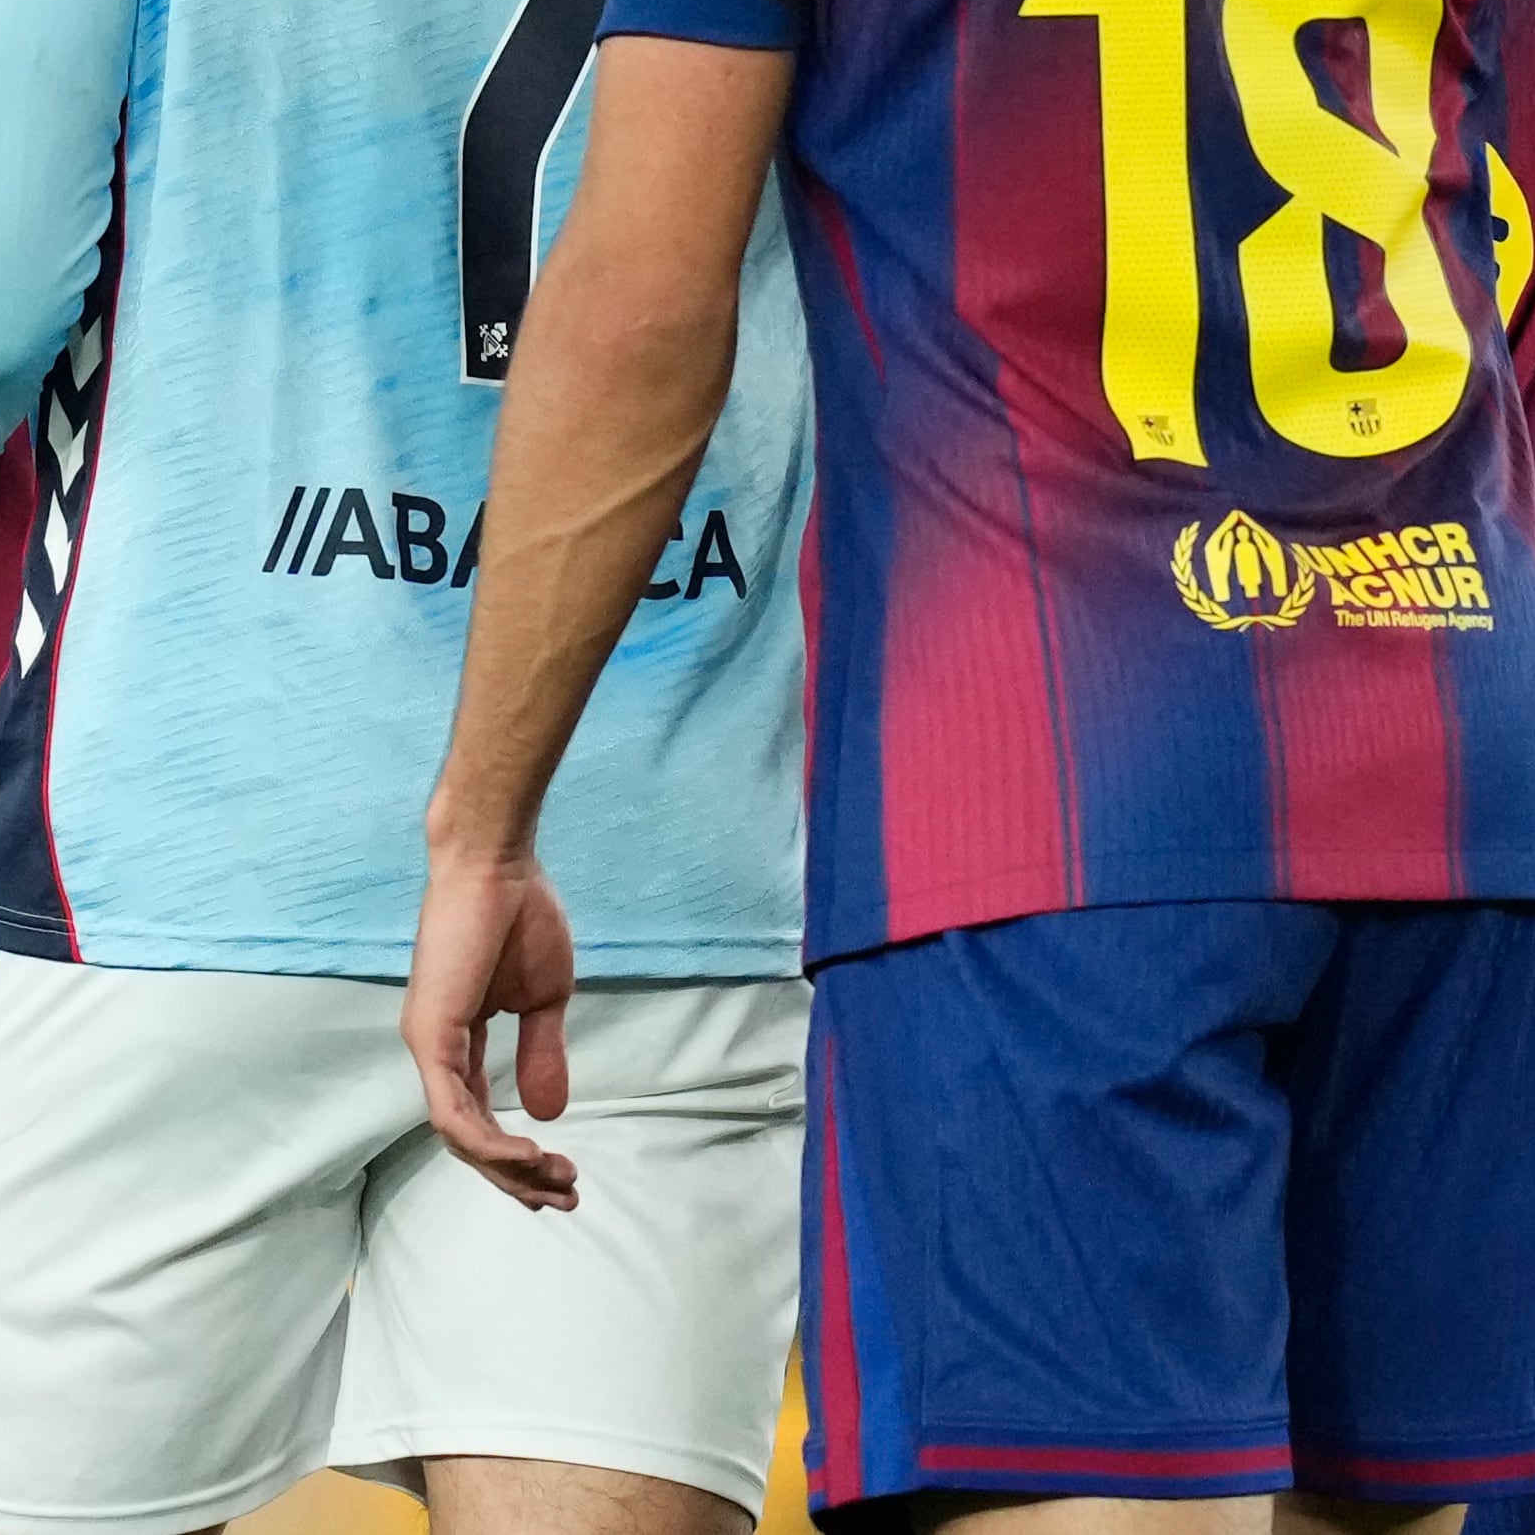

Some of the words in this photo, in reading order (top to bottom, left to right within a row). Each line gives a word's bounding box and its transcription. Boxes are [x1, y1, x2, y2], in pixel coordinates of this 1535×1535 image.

[1290, 522, 1477, 577] UNHCR
[1329, 564, 1491, 610] ACNUR
[1334, 609, 1365, 627] The
[1367, 610, 1391, 629] UN
